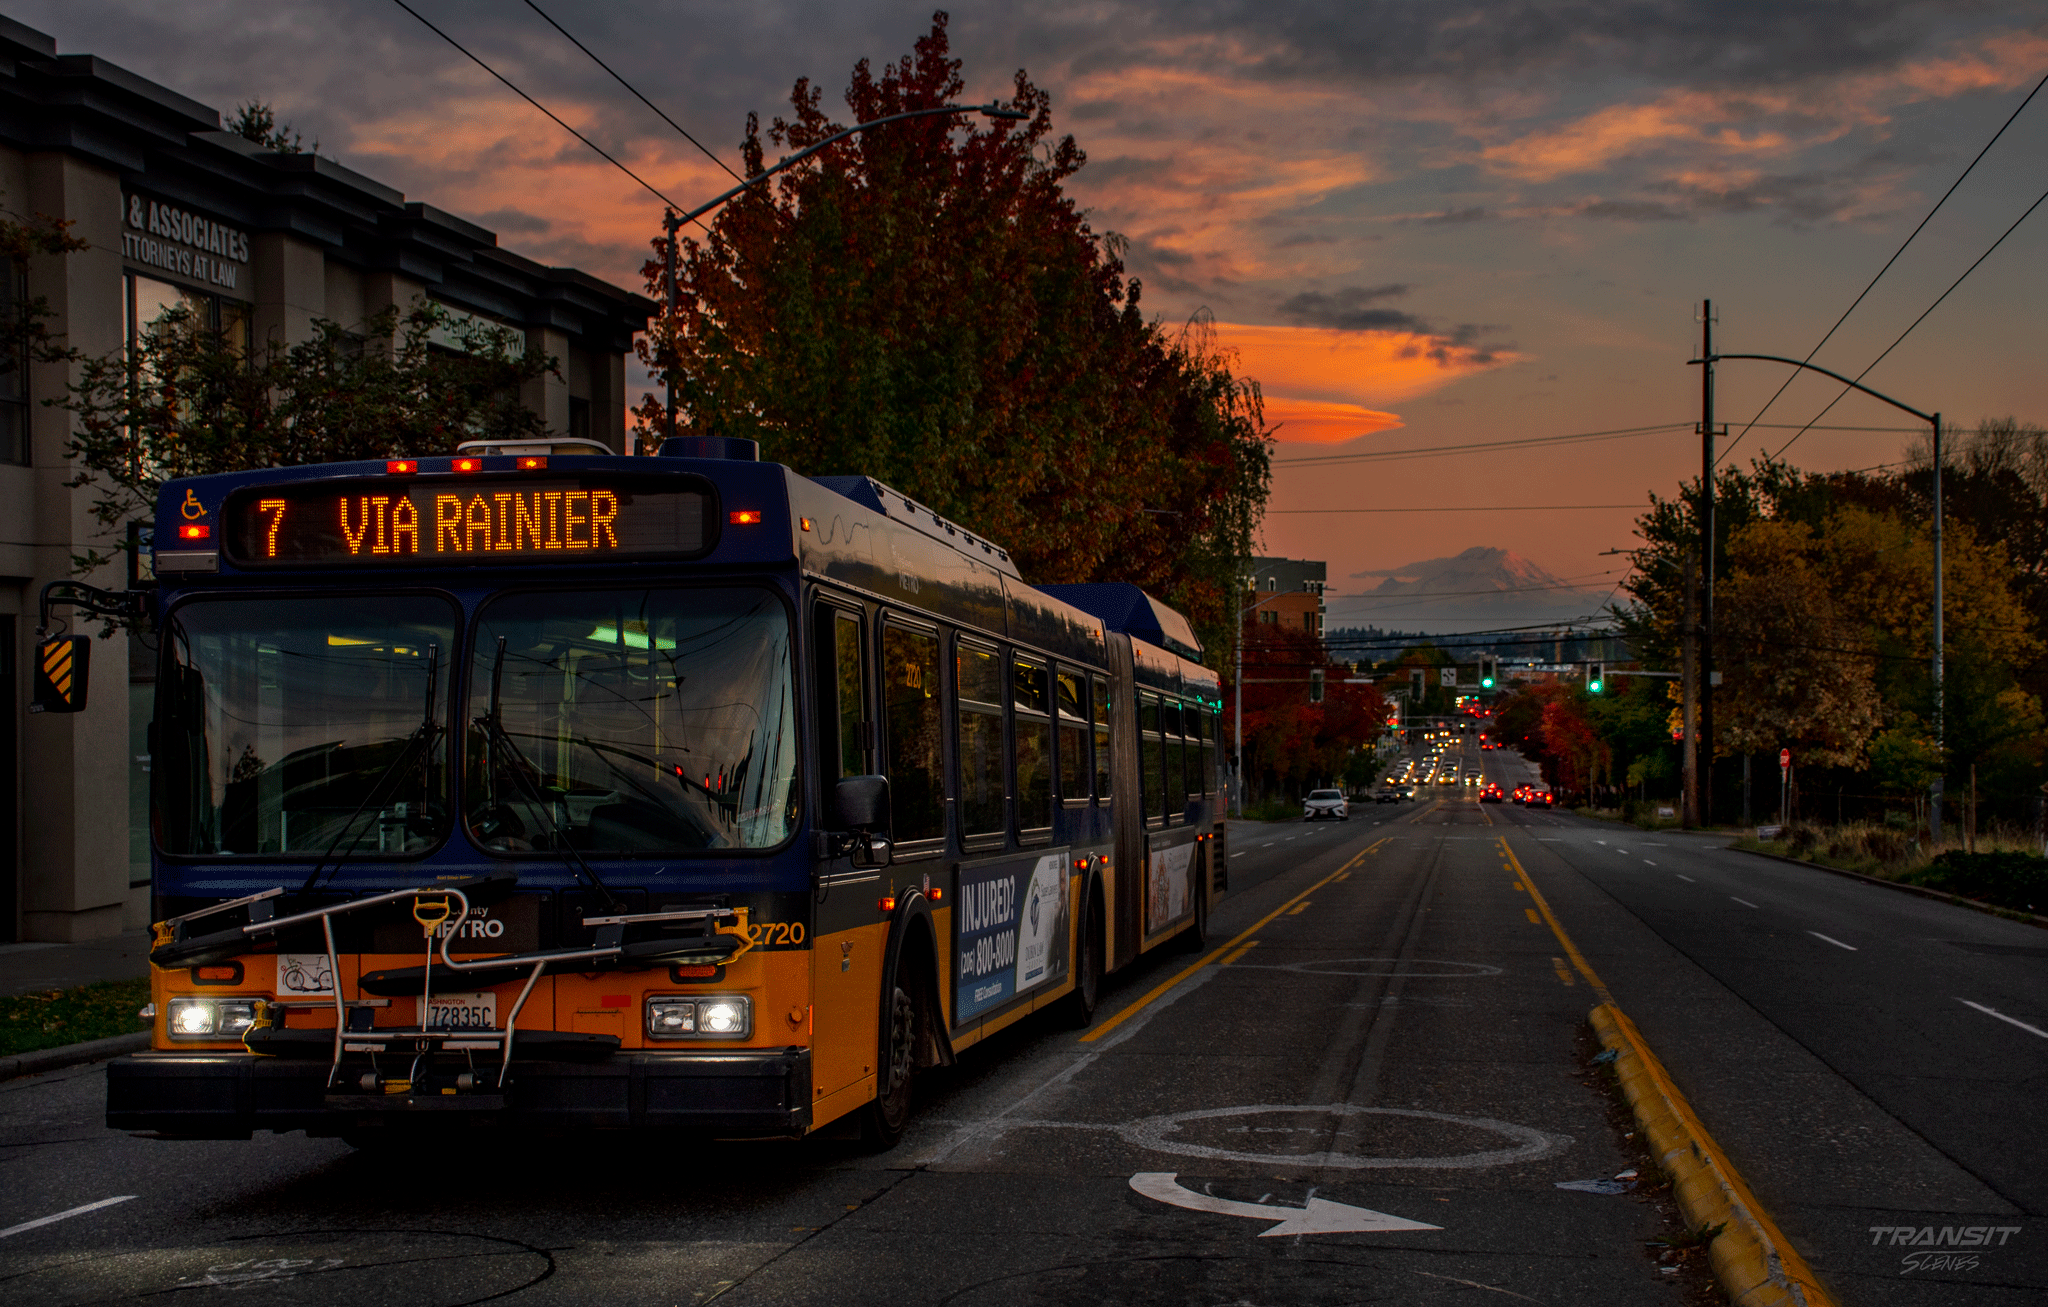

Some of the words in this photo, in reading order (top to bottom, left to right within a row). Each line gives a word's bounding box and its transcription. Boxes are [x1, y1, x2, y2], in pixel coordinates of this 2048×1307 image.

[130, 194, 144, 230] &
[149, 201, 249, 264] ASSOCIATES
[193, 254, 208, 280] AT
[211, 260, 236, 289] LAW
[260, 499, 286, 557] 7
[340, 495, 418, 555] VIA
[436, 490, 618, 552] RAINIER
[961, 875, 1016, 934] INJURED?
[748, 922, 806, 946] 2720
[960, 948, 976, 980] (206)
[976, 929, 1015, 977] 800-8000
[431, 1006, 491, 1028] 72835C
